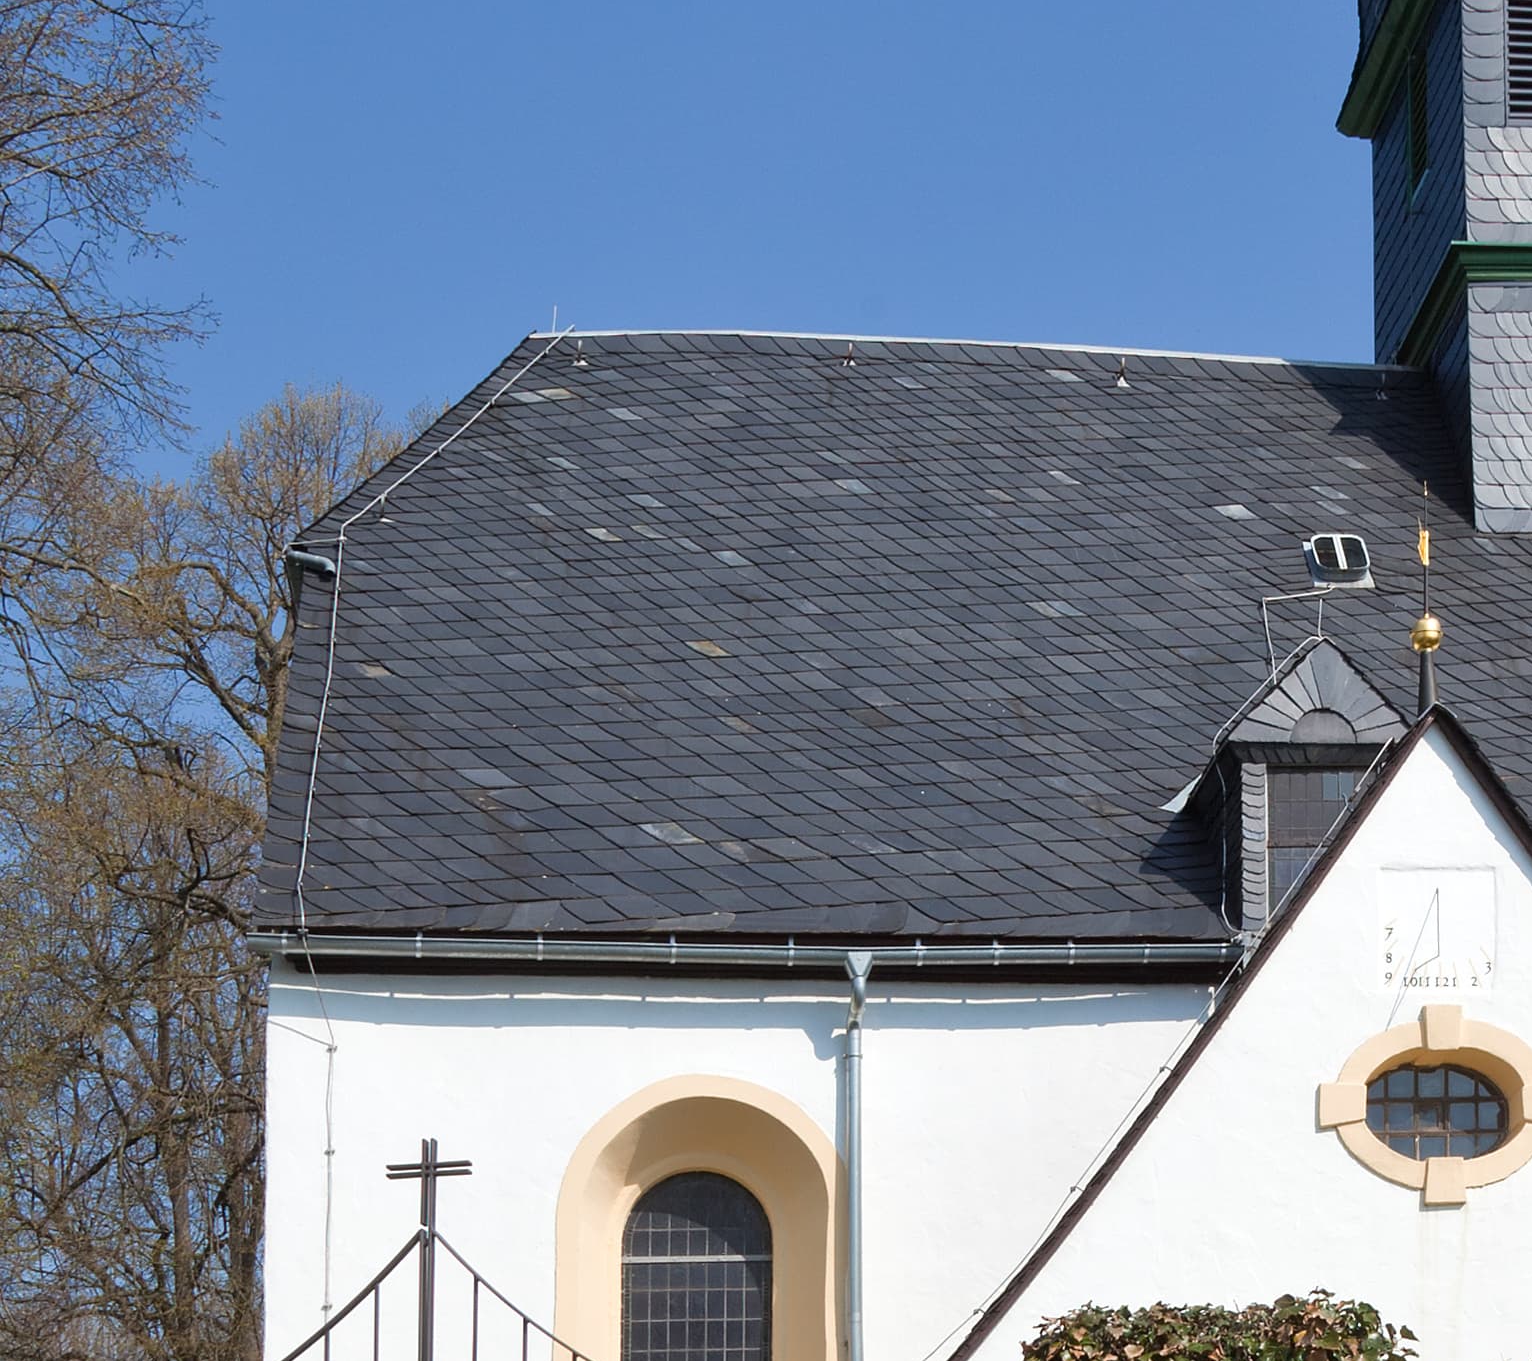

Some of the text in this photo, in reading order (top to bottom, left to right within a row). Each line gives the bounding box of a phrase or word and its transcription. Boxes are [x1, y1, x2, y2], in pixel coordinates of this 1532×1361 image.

[1384, 926, 1394, 942] 7
[1385, 952, 1393, 964] 8
[1484, 961, 1492, 976] 3
[1384, 971, 1393, 985] 9
[1402, 976, 1418, 987] 10
[1418, 976, 1430, 987] 11
[1435, 976, 1449, 987] 12
[1471, 976, 1479, 987] 2
